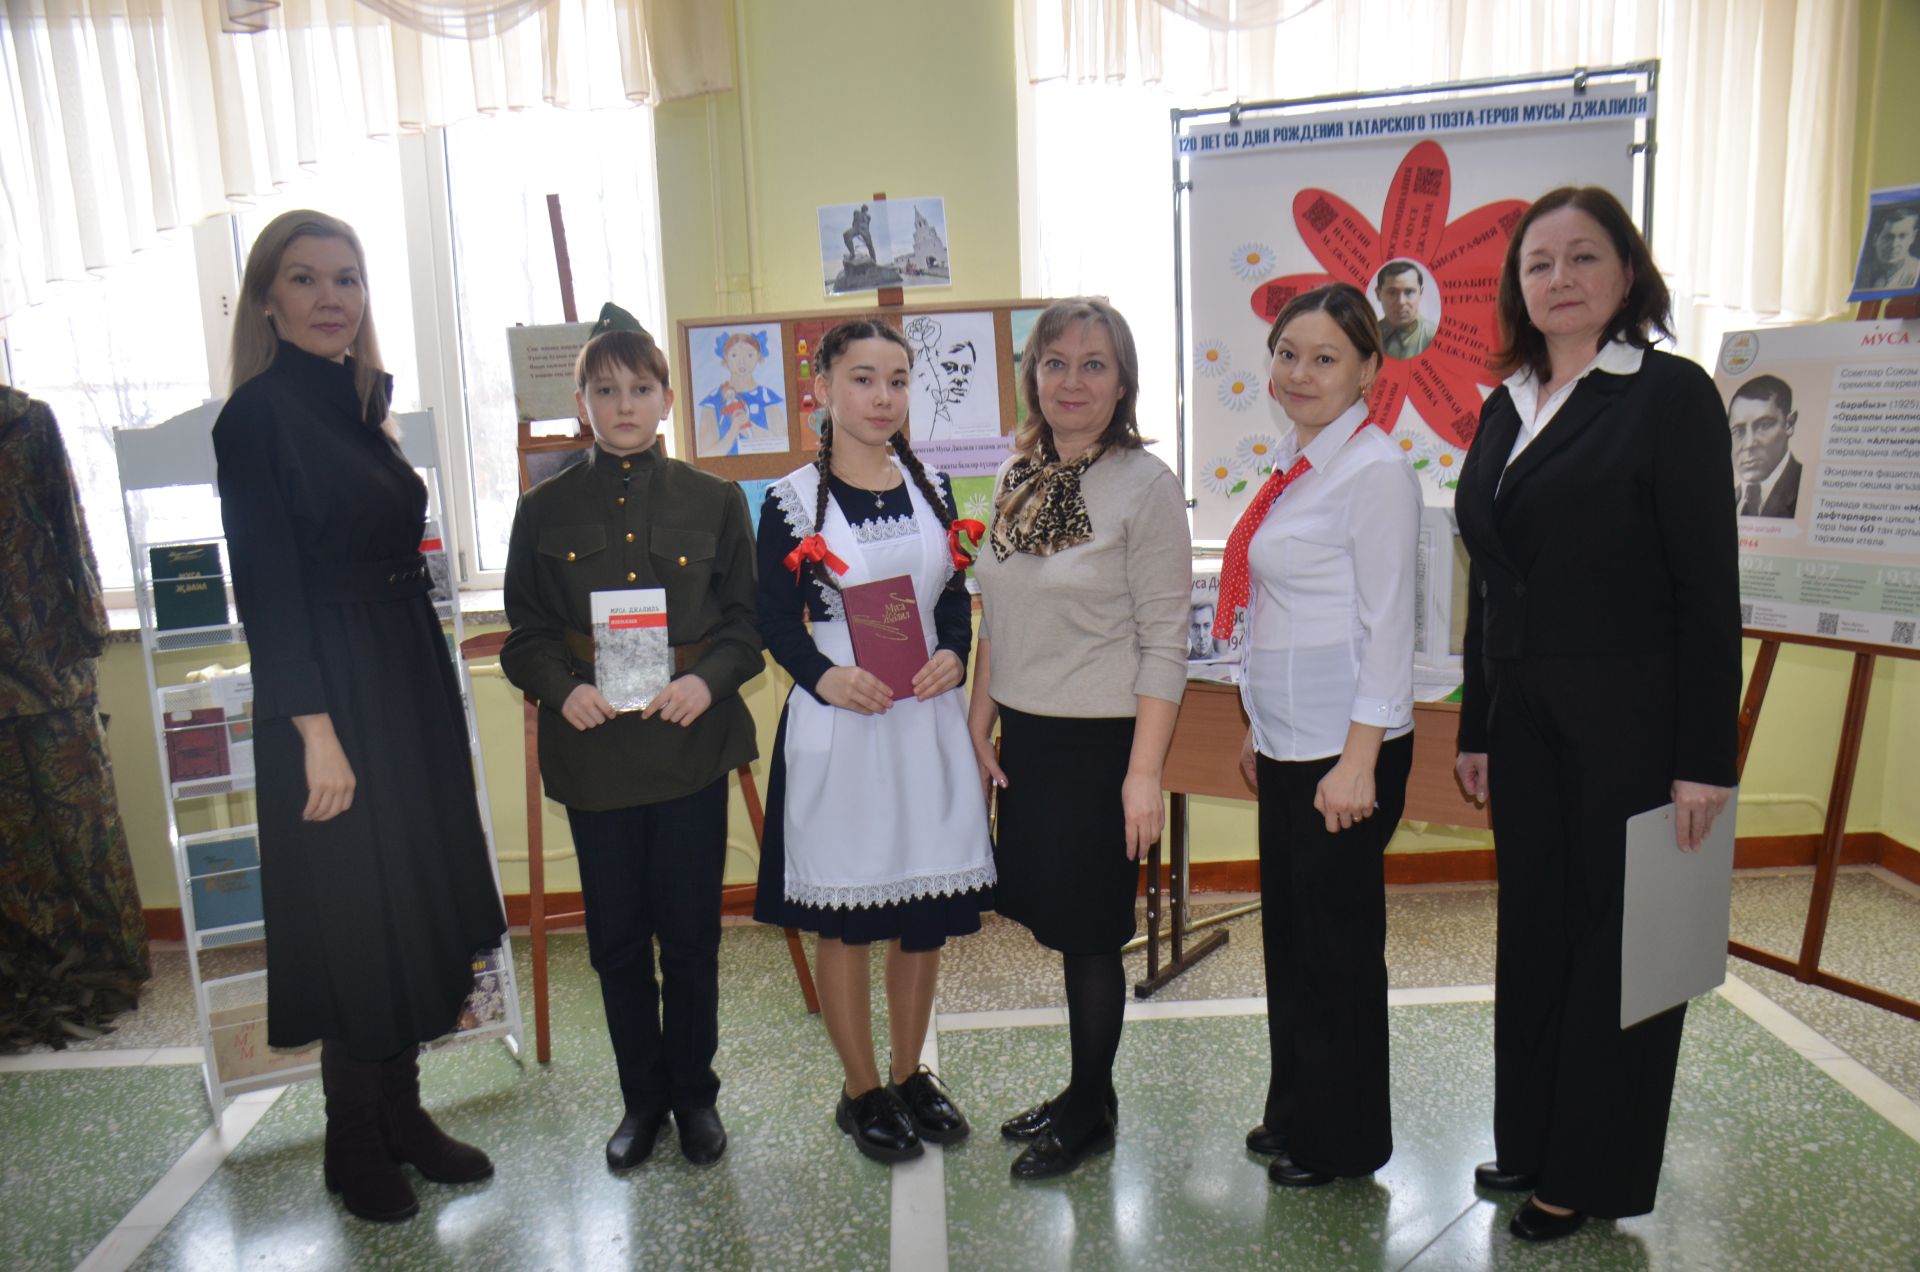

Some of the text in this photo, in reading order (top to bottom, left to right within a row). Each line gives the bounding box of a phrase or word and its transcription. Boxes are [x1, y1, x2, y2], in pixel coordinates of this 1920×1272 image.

[1179, 95, 1648, 152] 120 ЛЕТ СО ДНЯ РОЖДЕНИЯ ТАТАРСКОГО ПОЭТА-ГЕРОЯ МУСЫ ДЖАЛИЛЯ
[1342, 216, 1372, 249] ПЕСНИ
[1405, 208, 1418, 238] МУСЕ
[1332, 226, 1372, 271] НА СЛОВА
[1428, 226, 1499, 272] БИОГРАФИЯ
[1331, 247, 1370, 288] ДЖАЛИЛЯ
[1442, 277, 1498, 289] МОАБИТС
[1437, 326, 1491, 353] КВАРТИРА
[1443, 315, 1479, 336] МУЗЕЙ
[1861, 331, 1909, 347] МУСА
[1432, 339, 1490, 368] М.ДЖАЛИЛ
[1885, 366, 1918, 377] Союзы
[1412, 371, 1439, 408] ЛИРИКА
[1420, 358, 1463, 416] ФРОНТОВАЯ
[1860, 524, 1875, 534] 60
